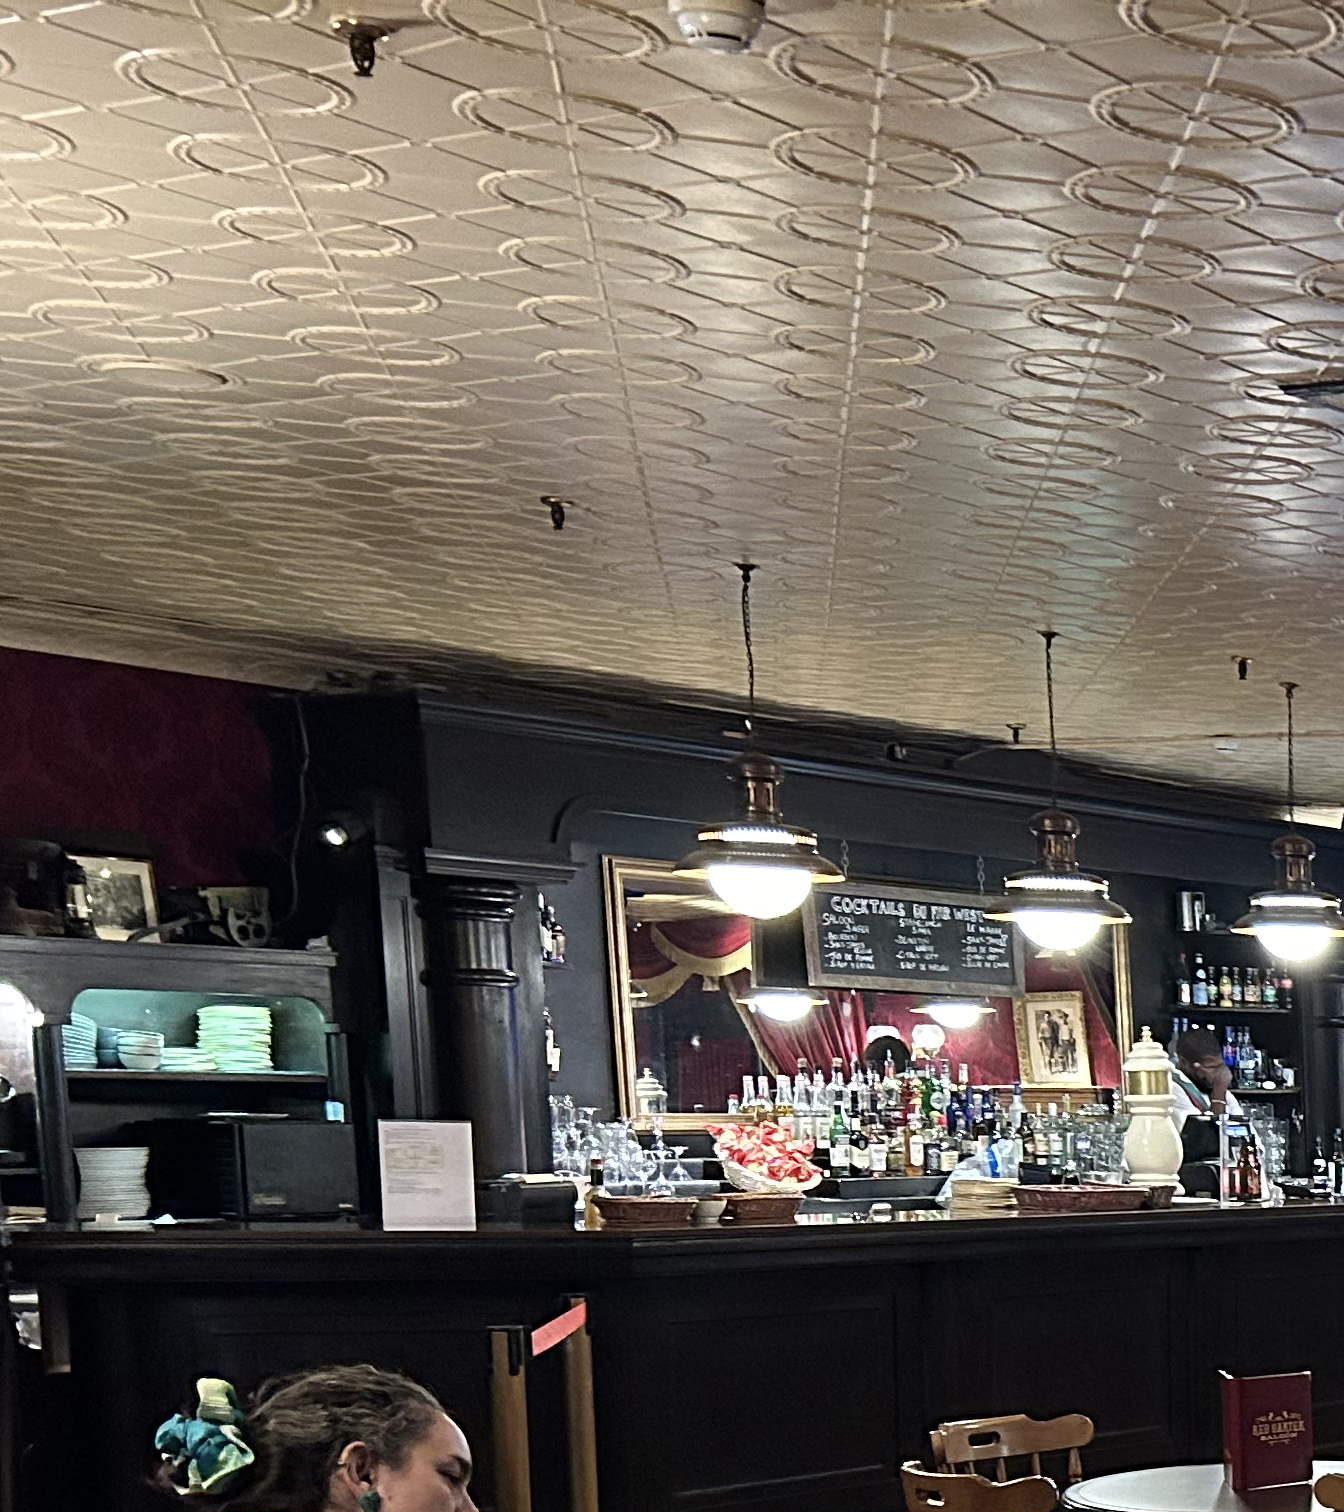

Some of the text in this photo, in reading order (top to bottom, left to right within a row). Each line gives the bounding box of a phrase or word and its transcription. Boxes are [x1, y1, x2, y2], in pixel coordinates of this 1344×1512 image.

[831, 896, 905, 917] COCKTAILS
[953, 908, 985, 923] WEST
[1252, 1420, 1306, 1437] RED GARTER
[1260, 1432, 1298, 1441] SALOON
